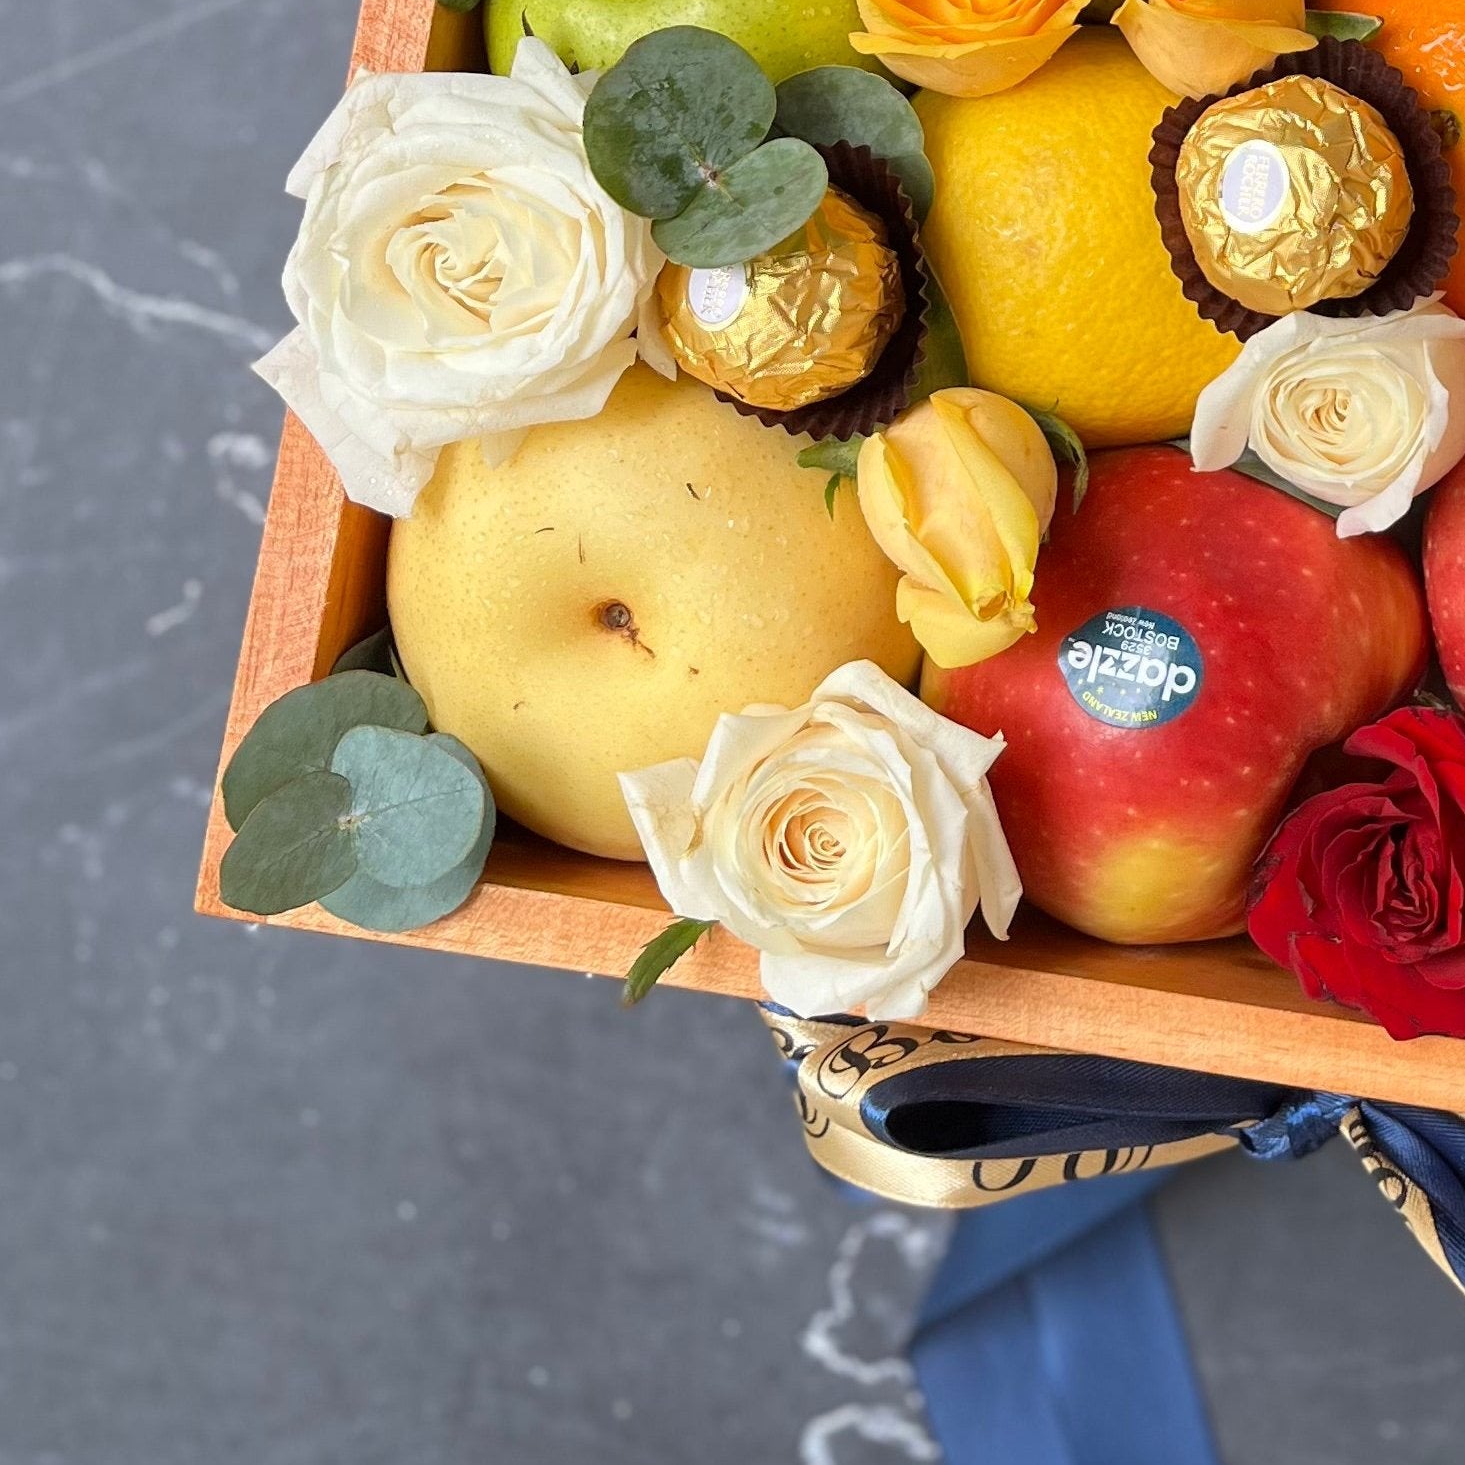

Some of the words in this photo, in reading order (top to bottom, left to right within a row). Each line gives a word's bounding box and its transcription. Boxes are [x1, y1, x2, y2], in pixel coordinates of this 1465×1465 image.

[1102, 620, 1181, 651] BOSTOCK
[1121, 640, 1153, 656] 3529
[1067, 640, 1197, 702] dazzle
[1082, 690, 1129, 722] ZEALAND
[1131, 709, 1158, 722] NEW
